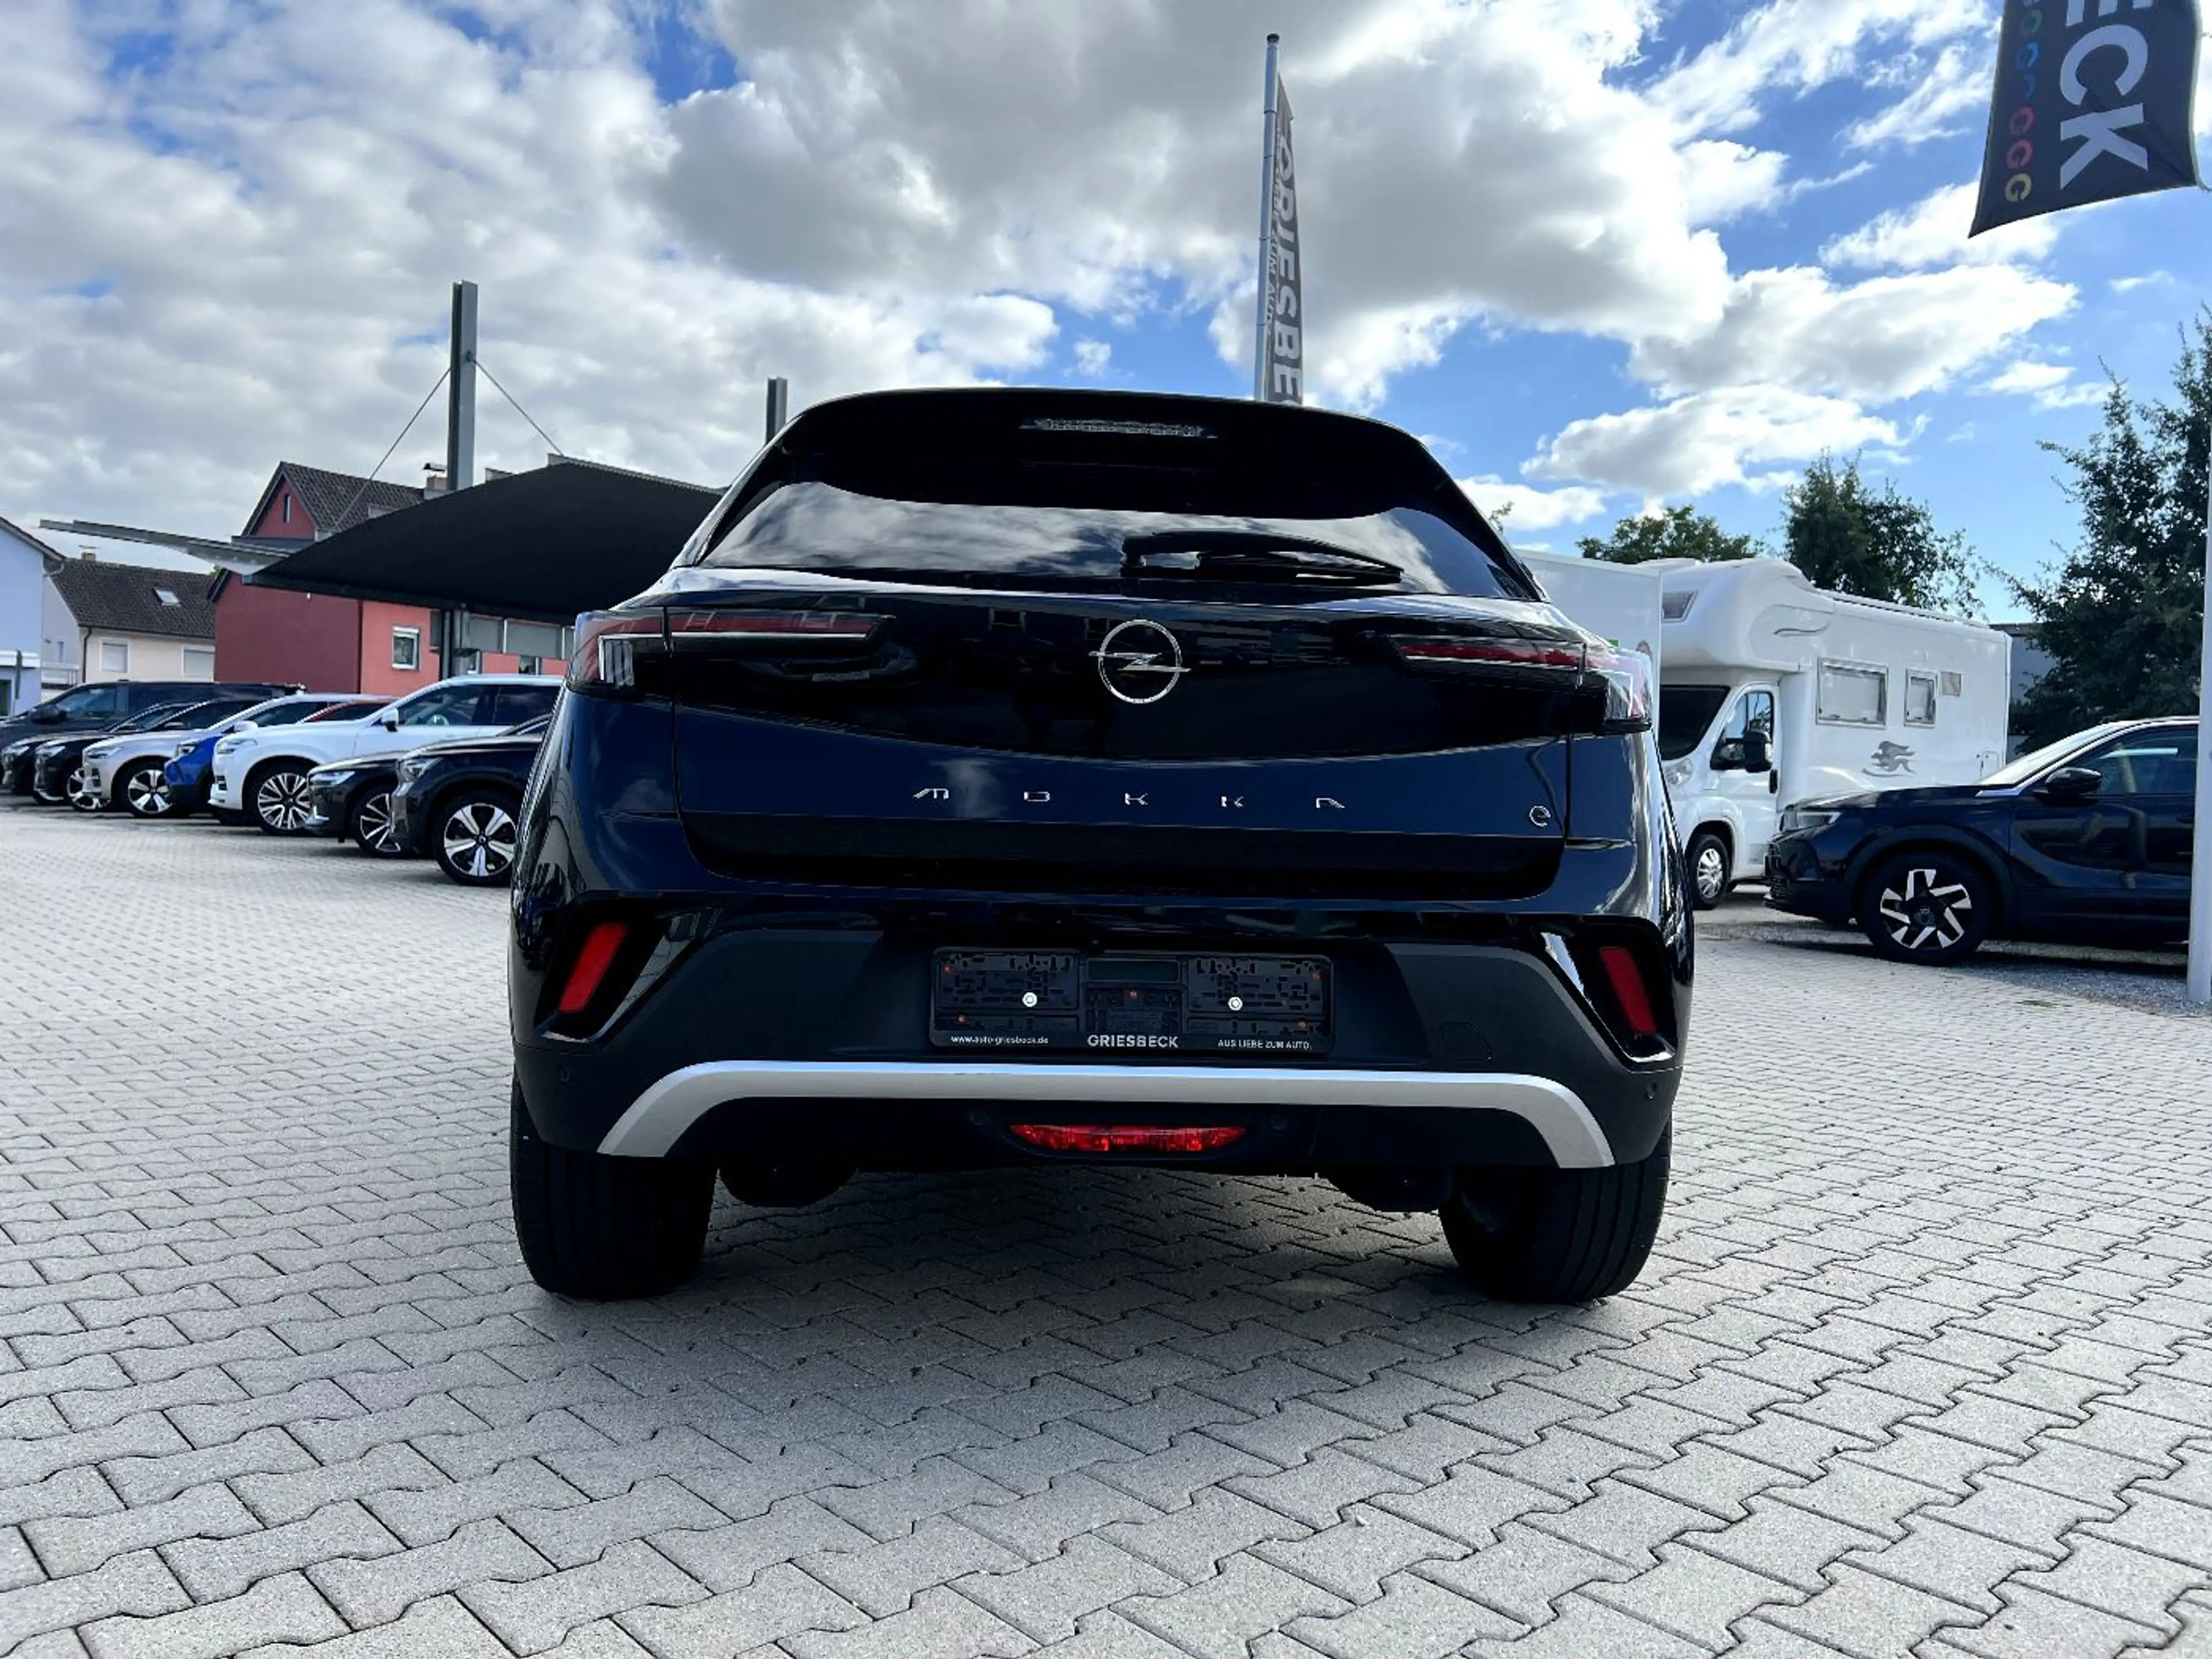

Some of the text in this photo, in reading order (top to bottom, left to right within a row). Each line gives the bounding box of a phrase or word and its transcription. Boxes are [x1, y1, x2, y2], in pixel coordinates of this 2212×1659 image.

[1273, 134, 1302, 403] GRIESBE
[912, 788, 1345, 808] MOKKA
[1087, 1035, 1179, 1048] GRIESBECK
[1218, 1039, 1237, 1048] AUS
[1238, 1040, 1263, 1048] LIEBE
